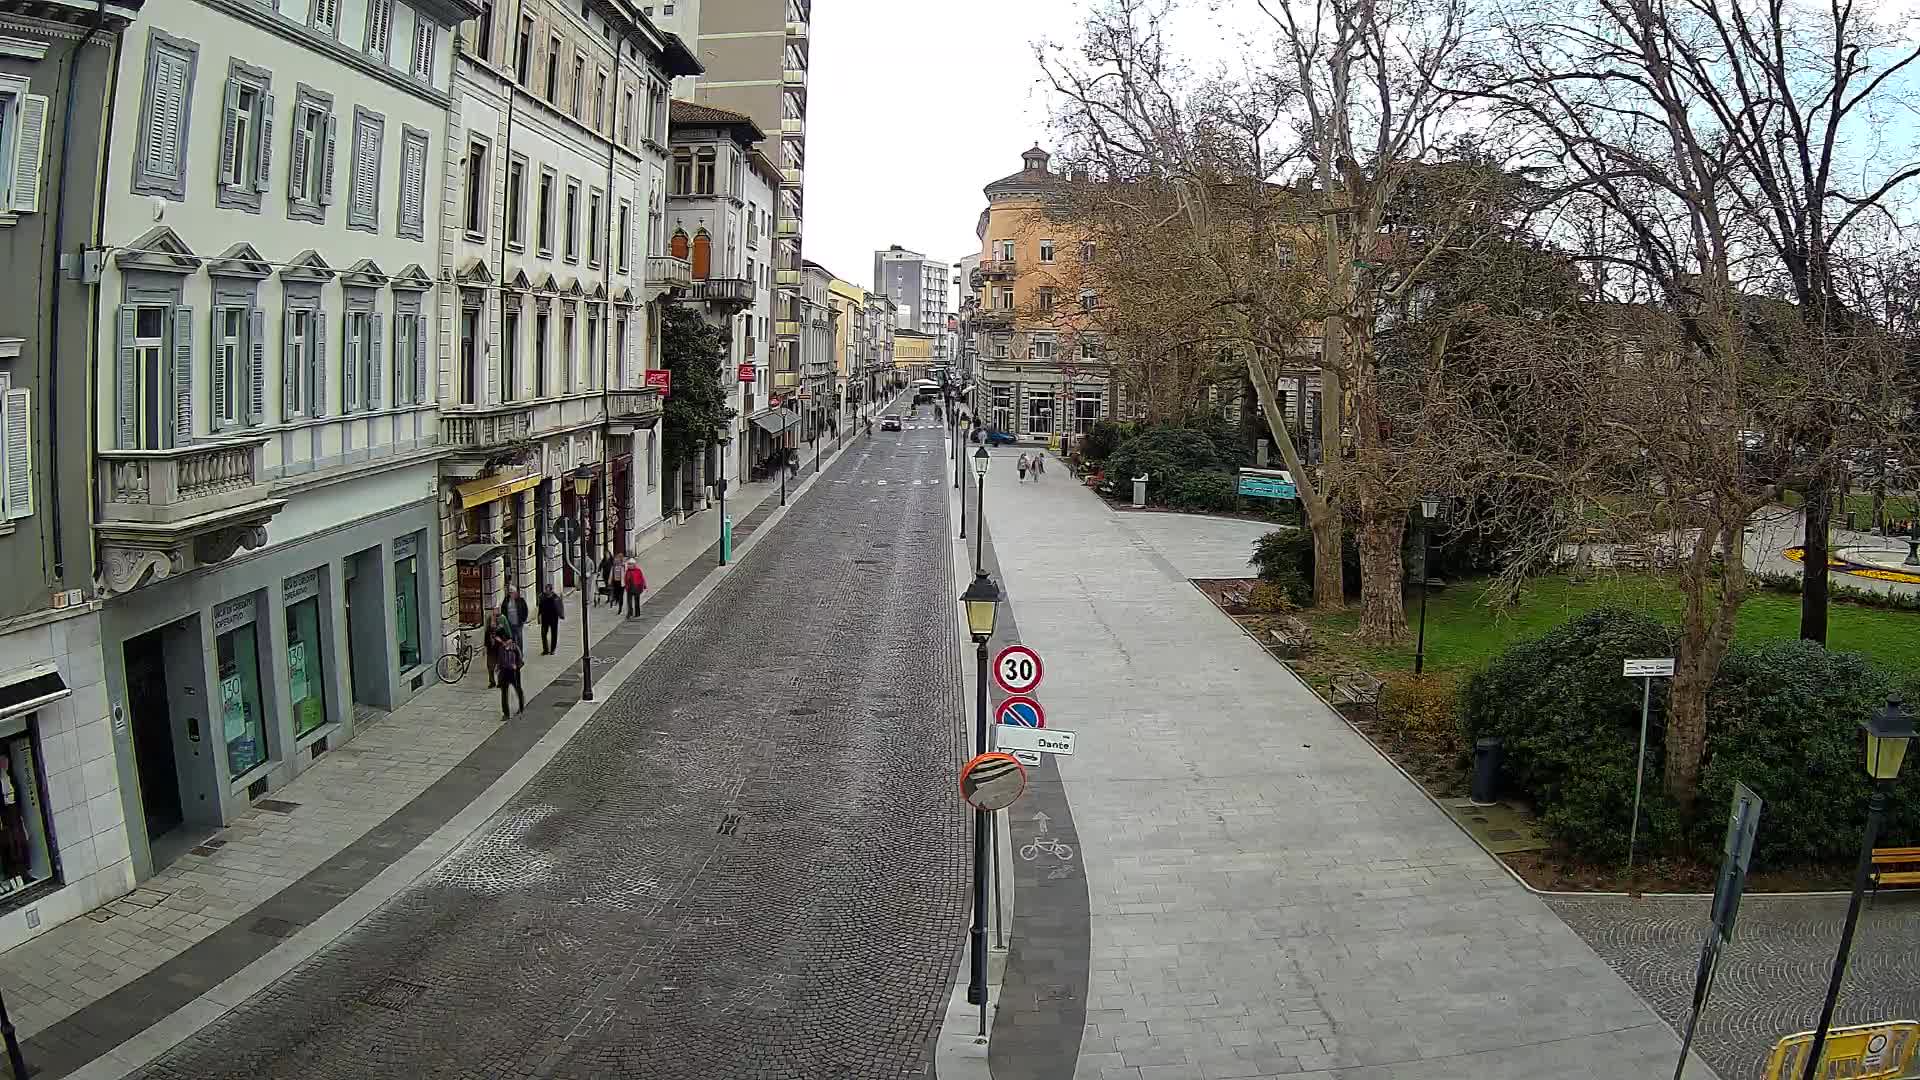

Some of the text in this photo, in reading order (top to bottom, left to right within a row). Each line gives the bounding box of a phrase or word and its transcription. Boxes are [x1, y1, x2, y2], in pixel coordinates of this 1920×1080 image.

[1004, 658, 1033, 681] 30
[221, 677, 240, 701] 130
[1038, 738, 1070, 750] Dante
